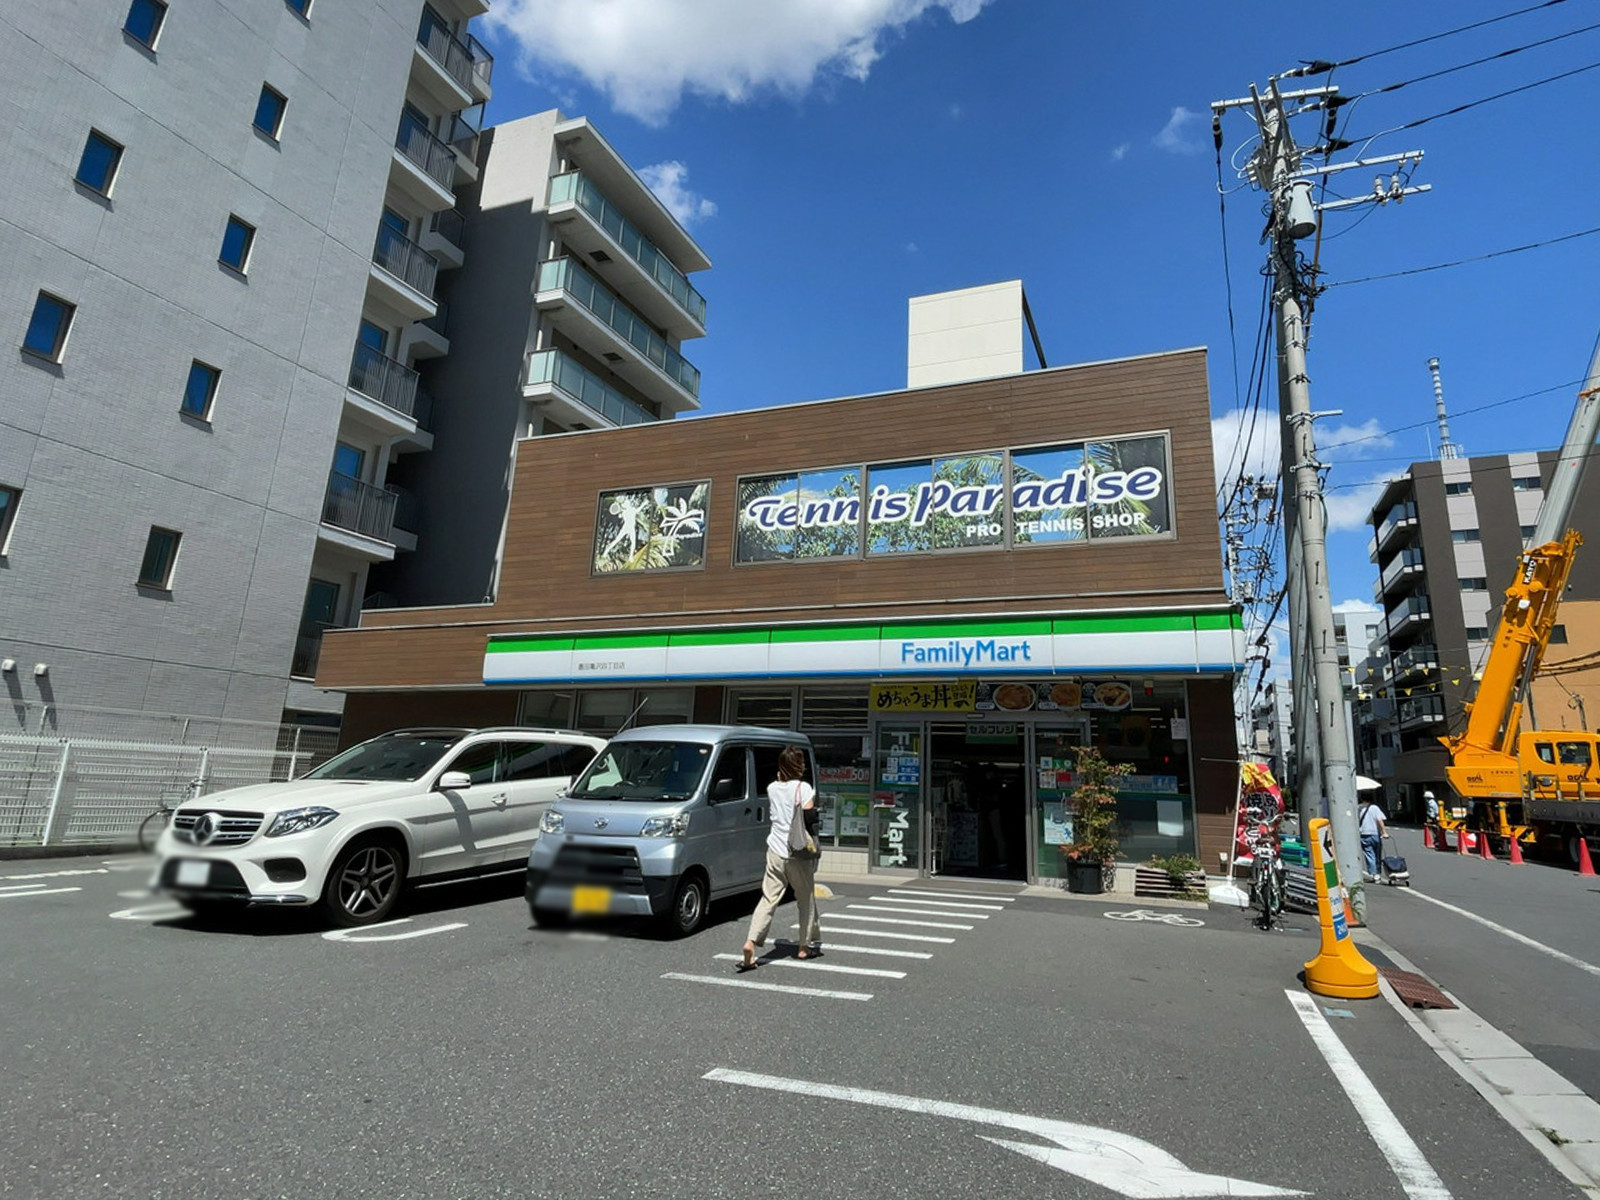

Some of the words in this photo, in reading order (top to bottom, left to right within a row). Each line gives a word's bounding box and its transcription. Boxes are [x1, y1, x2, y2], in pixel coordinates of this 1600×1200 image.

[748, 485, 909, 529] Tennis
[914, 464, 1162, 526] Paradise
[966, 522, 1001, 539] PRO
[1017, 517, 1085, 536] TENNIS
[1092, 511, 1147, 530] SHOP
[1523, 559, 1537, 585] KATO
[901, 639, 1031, 667] FamilyMart
[969, 724, 1015, 735] セルフレジ
